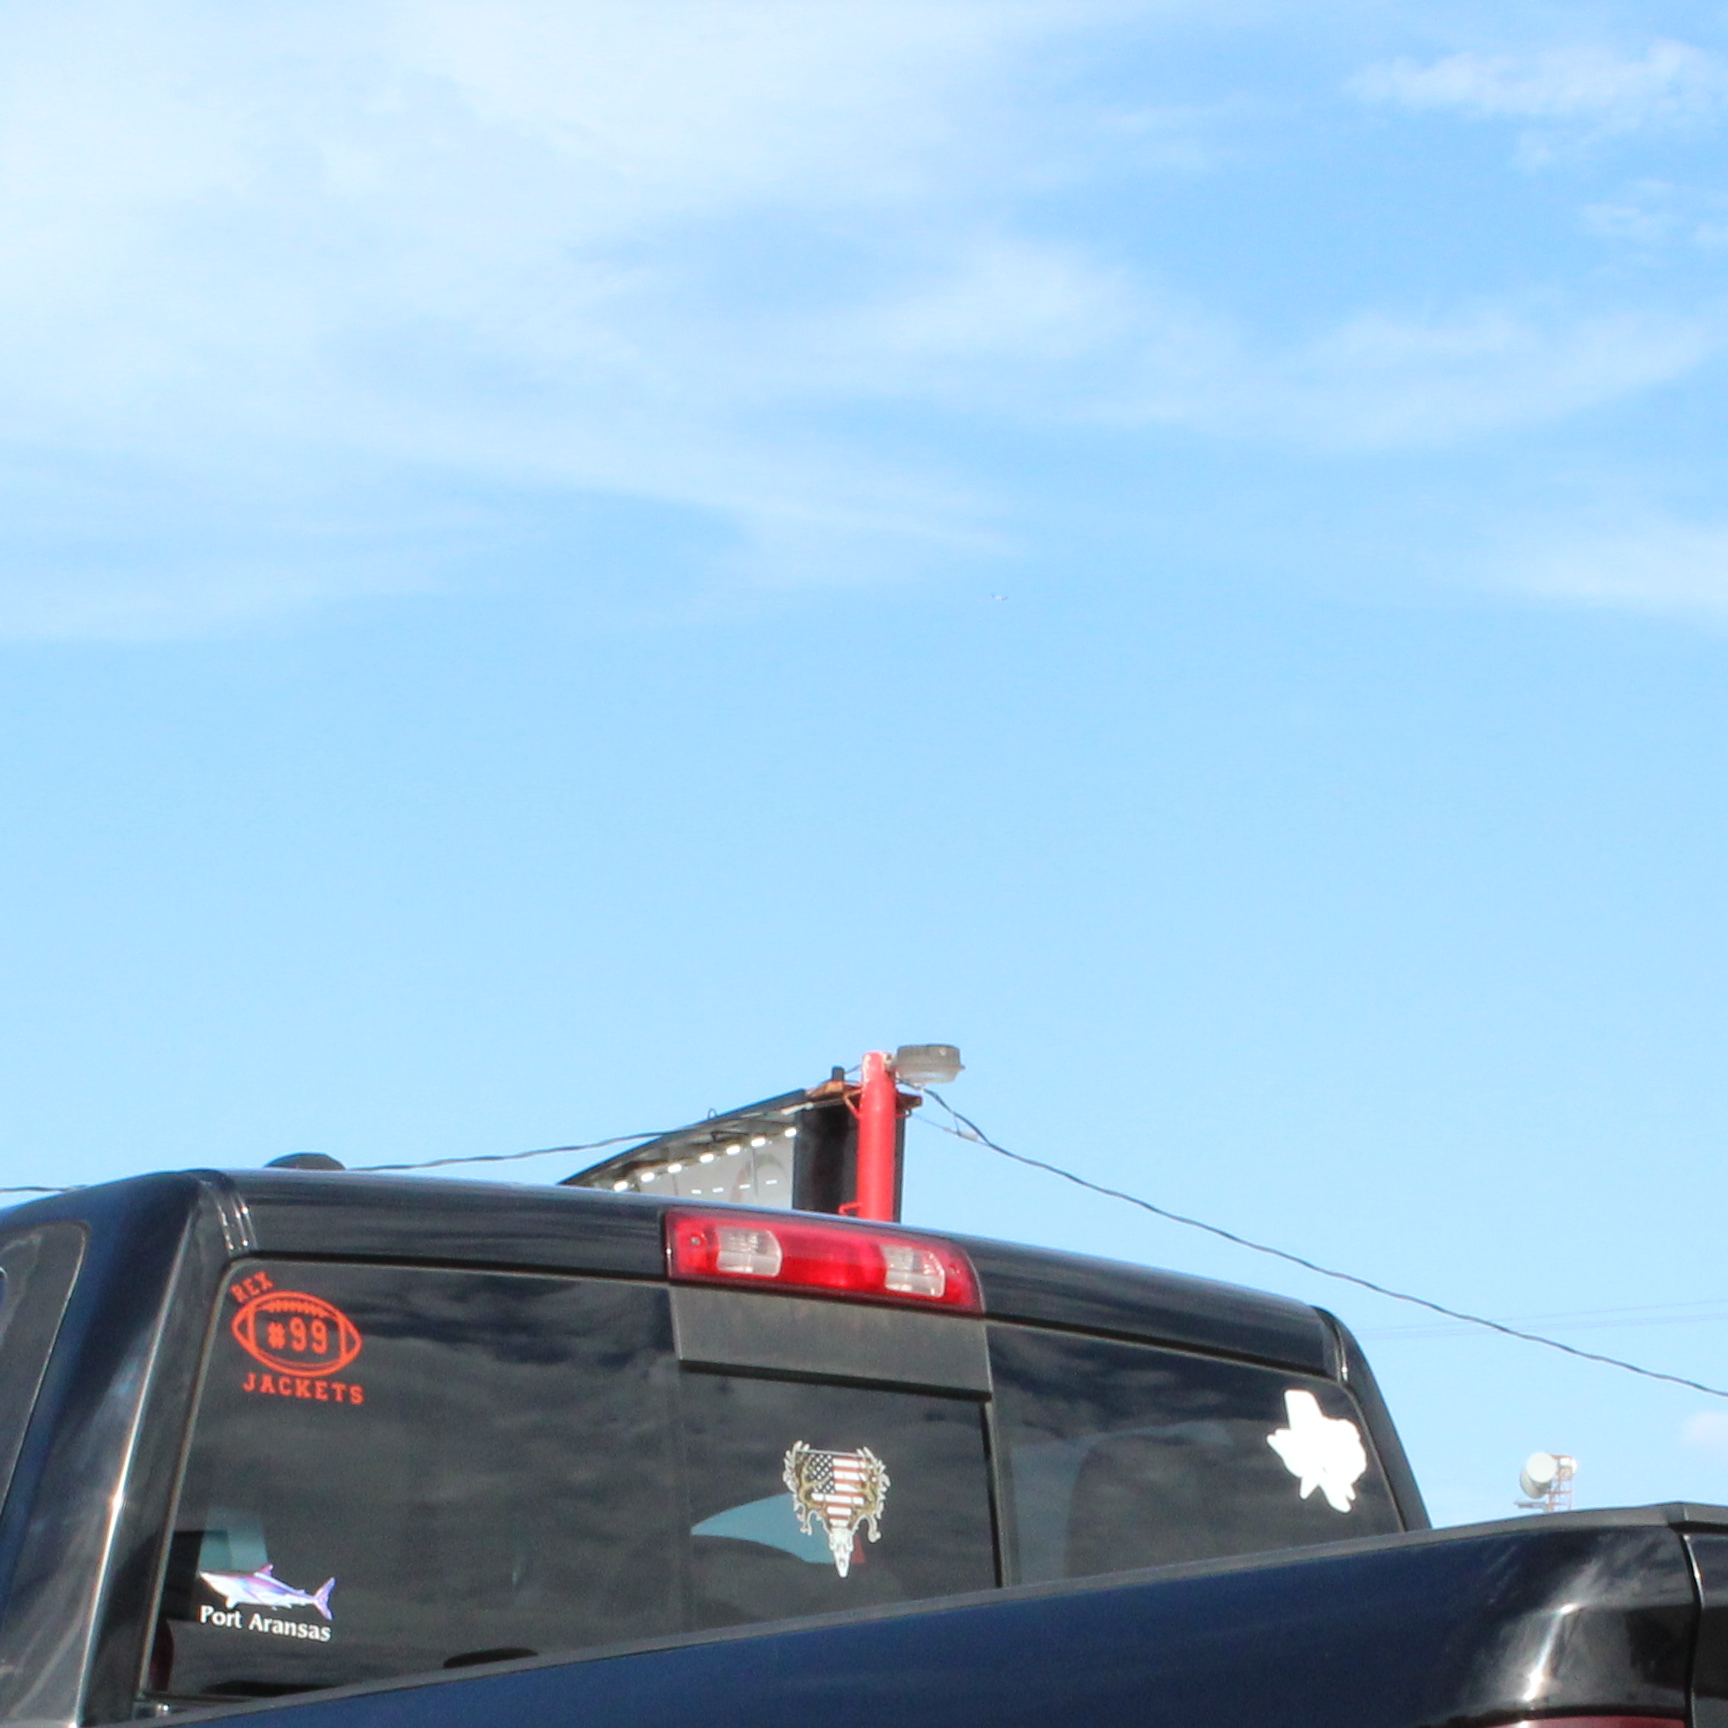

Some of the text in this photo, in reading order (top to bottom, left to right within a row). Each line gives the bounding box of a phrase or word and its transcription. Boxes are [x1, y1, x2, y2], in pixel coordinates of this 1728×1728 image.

[267, 1316, 328, 1354] #99
[242, 1372, 364, 1404] JACKETS
[199, 1604, 332, 1643] Port Aransas
